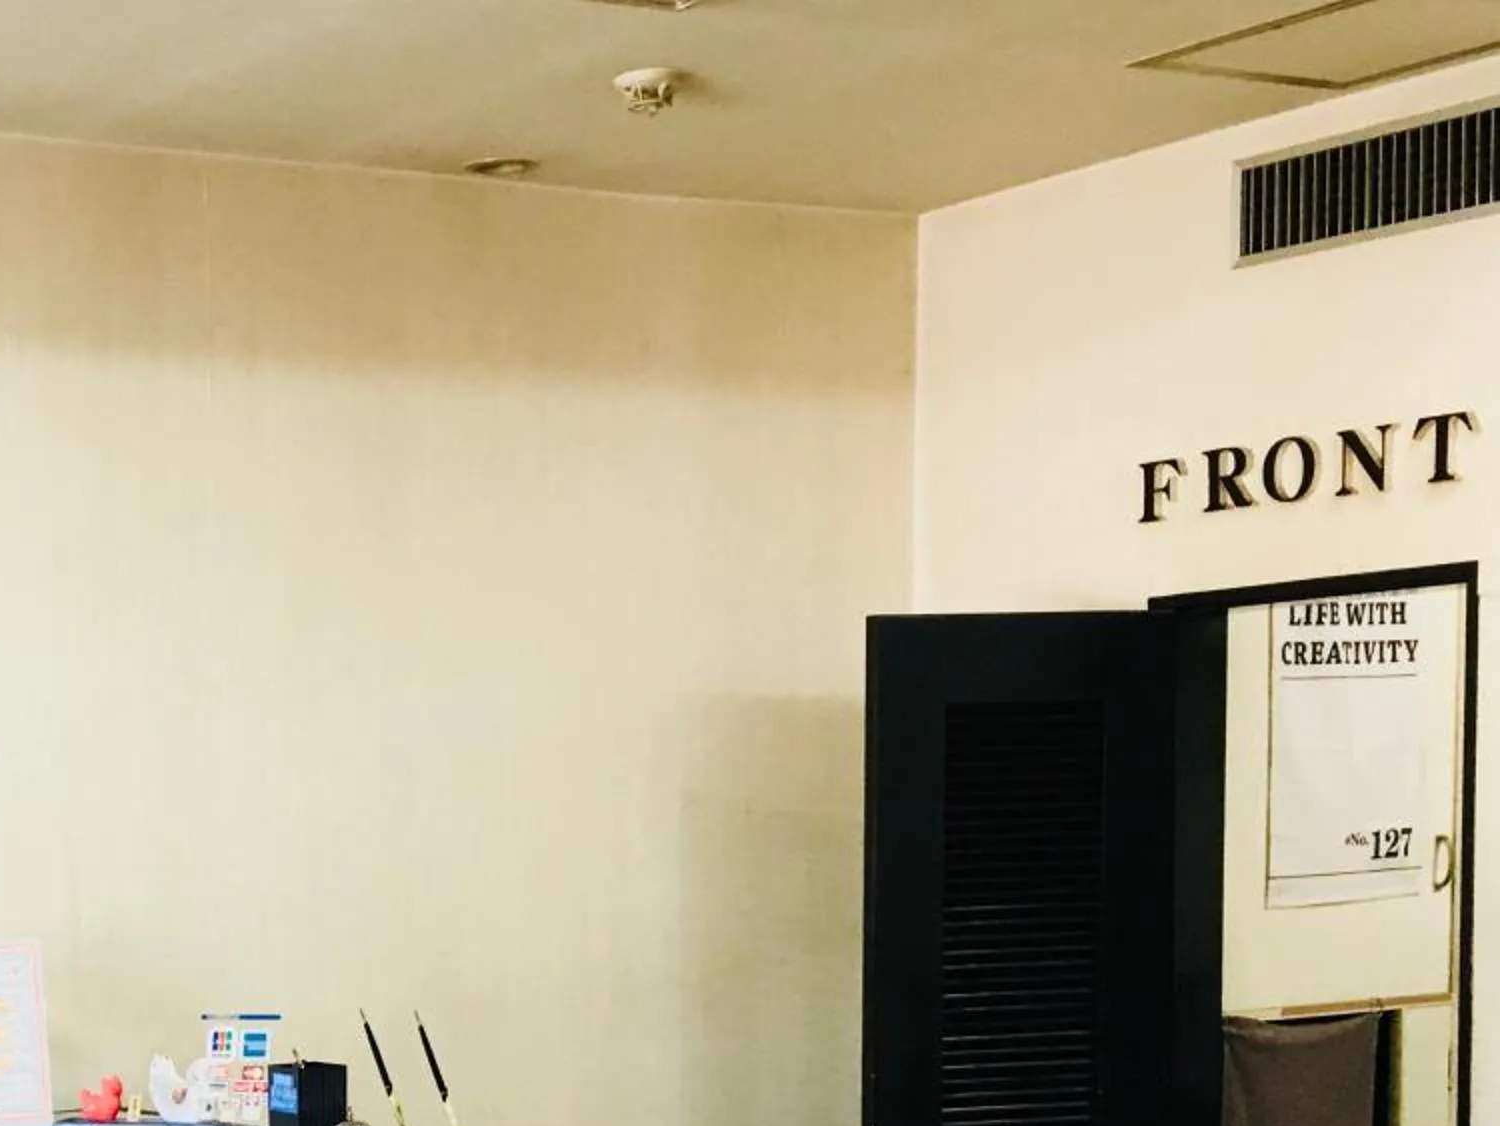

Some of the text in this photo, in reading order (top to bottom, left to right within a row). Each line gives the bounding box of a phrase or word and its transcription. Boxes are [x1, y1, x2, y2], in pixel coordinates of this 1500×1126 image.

[1138, 411, 1475, 523] FRONT
[1289, 601, 1407, 626] LIFE WITH
[1281, 639, 1419, 665] CREATIVITY
[1370, 827, 1412, 860] 127
